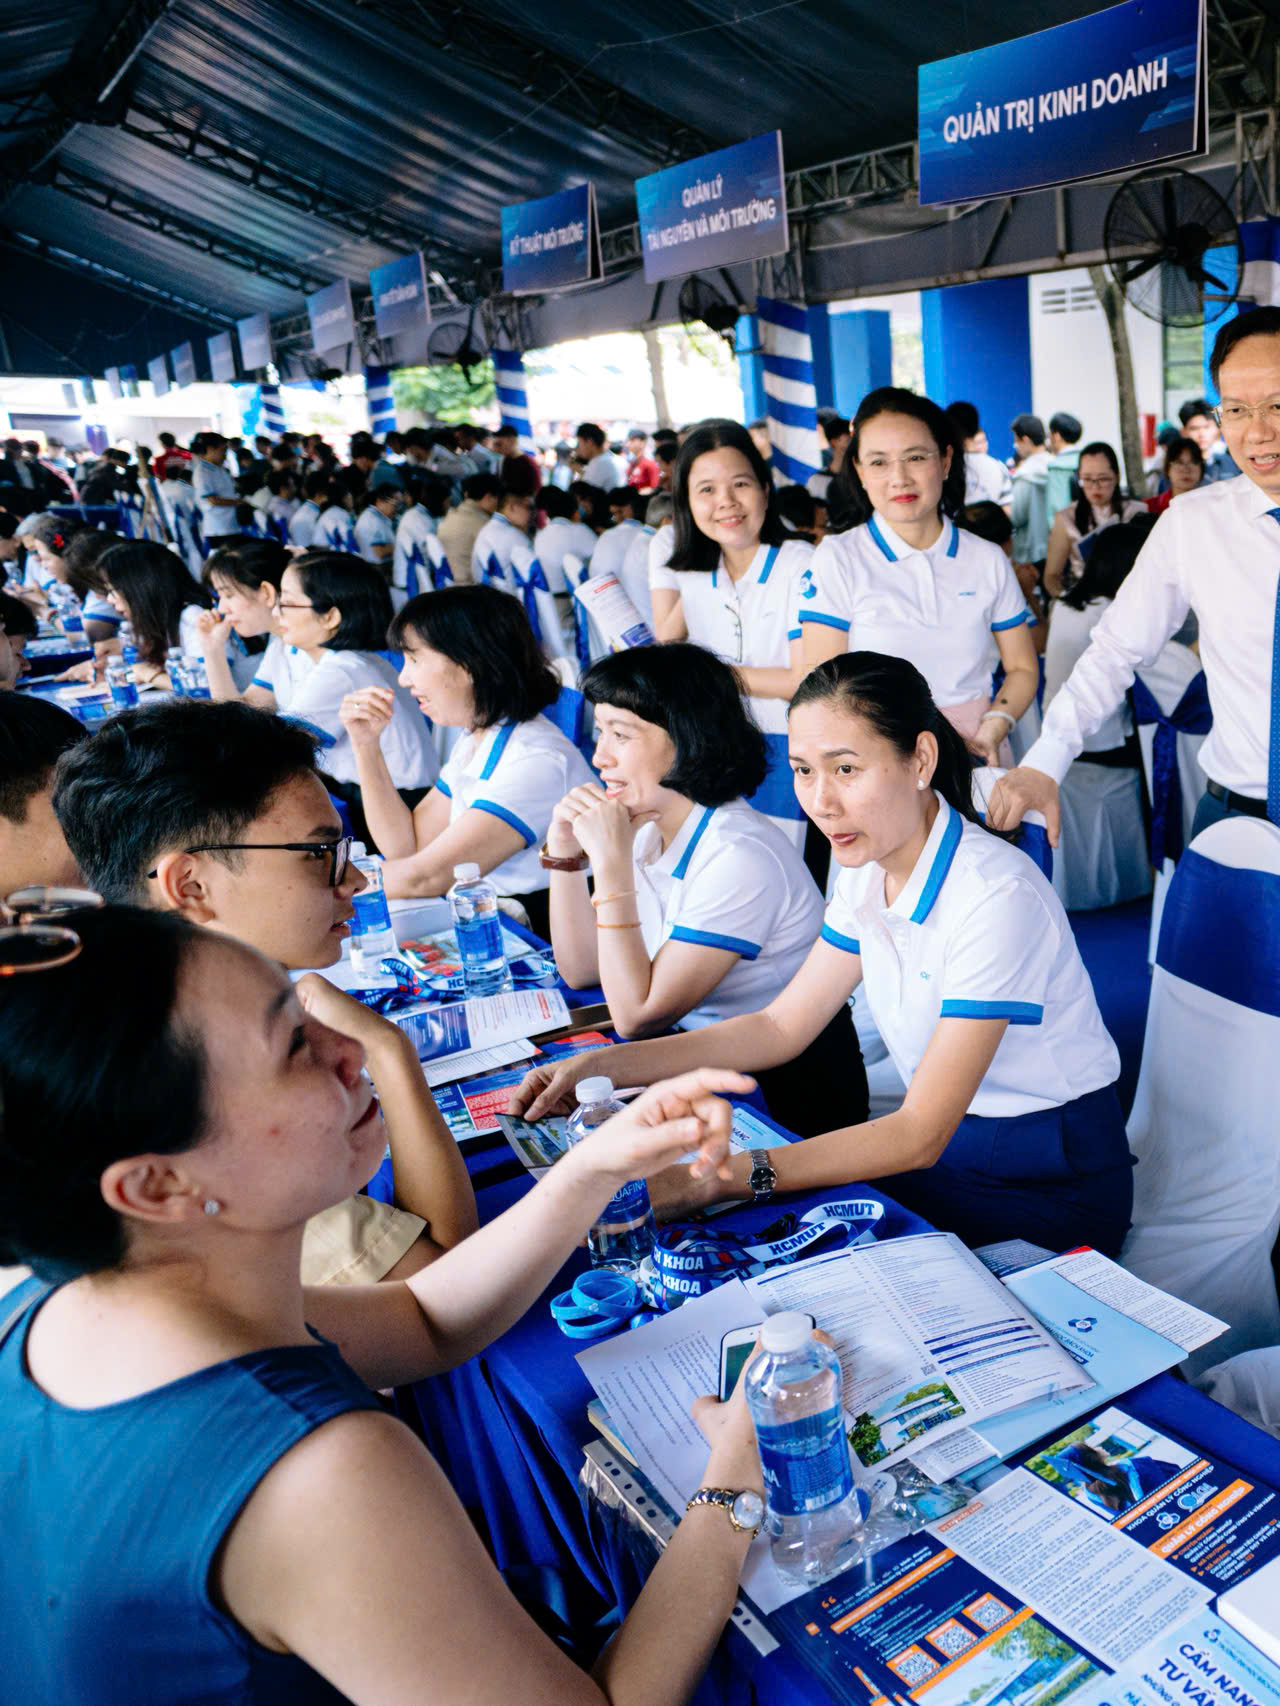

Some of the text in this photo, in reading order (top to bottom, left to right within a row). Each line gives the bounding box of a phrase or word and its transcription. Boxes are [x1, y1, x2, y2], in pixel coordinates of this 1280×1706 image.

[943, 57, 1168, 143] QUẢN TRỊ KINH DOANH
[709, 208, 731, 233] MÔI
[731, 198, 777, 229] TRƯỜNG
[822, 1203, 875, 1218] HCMUT
[768, 1222, 826, 1256] HCMUT
[662, 1253, 704, 1270] KHOA
[661, 1273, 702, 1295] KHOA
[1125, 1514, 1148, 1530] KHOA
[1158, 1658, 1189, 1681] TƯ
[1178, 1643, 1217, 1677] CẨM
[1214, 1674, 1262, 1706] NAN
